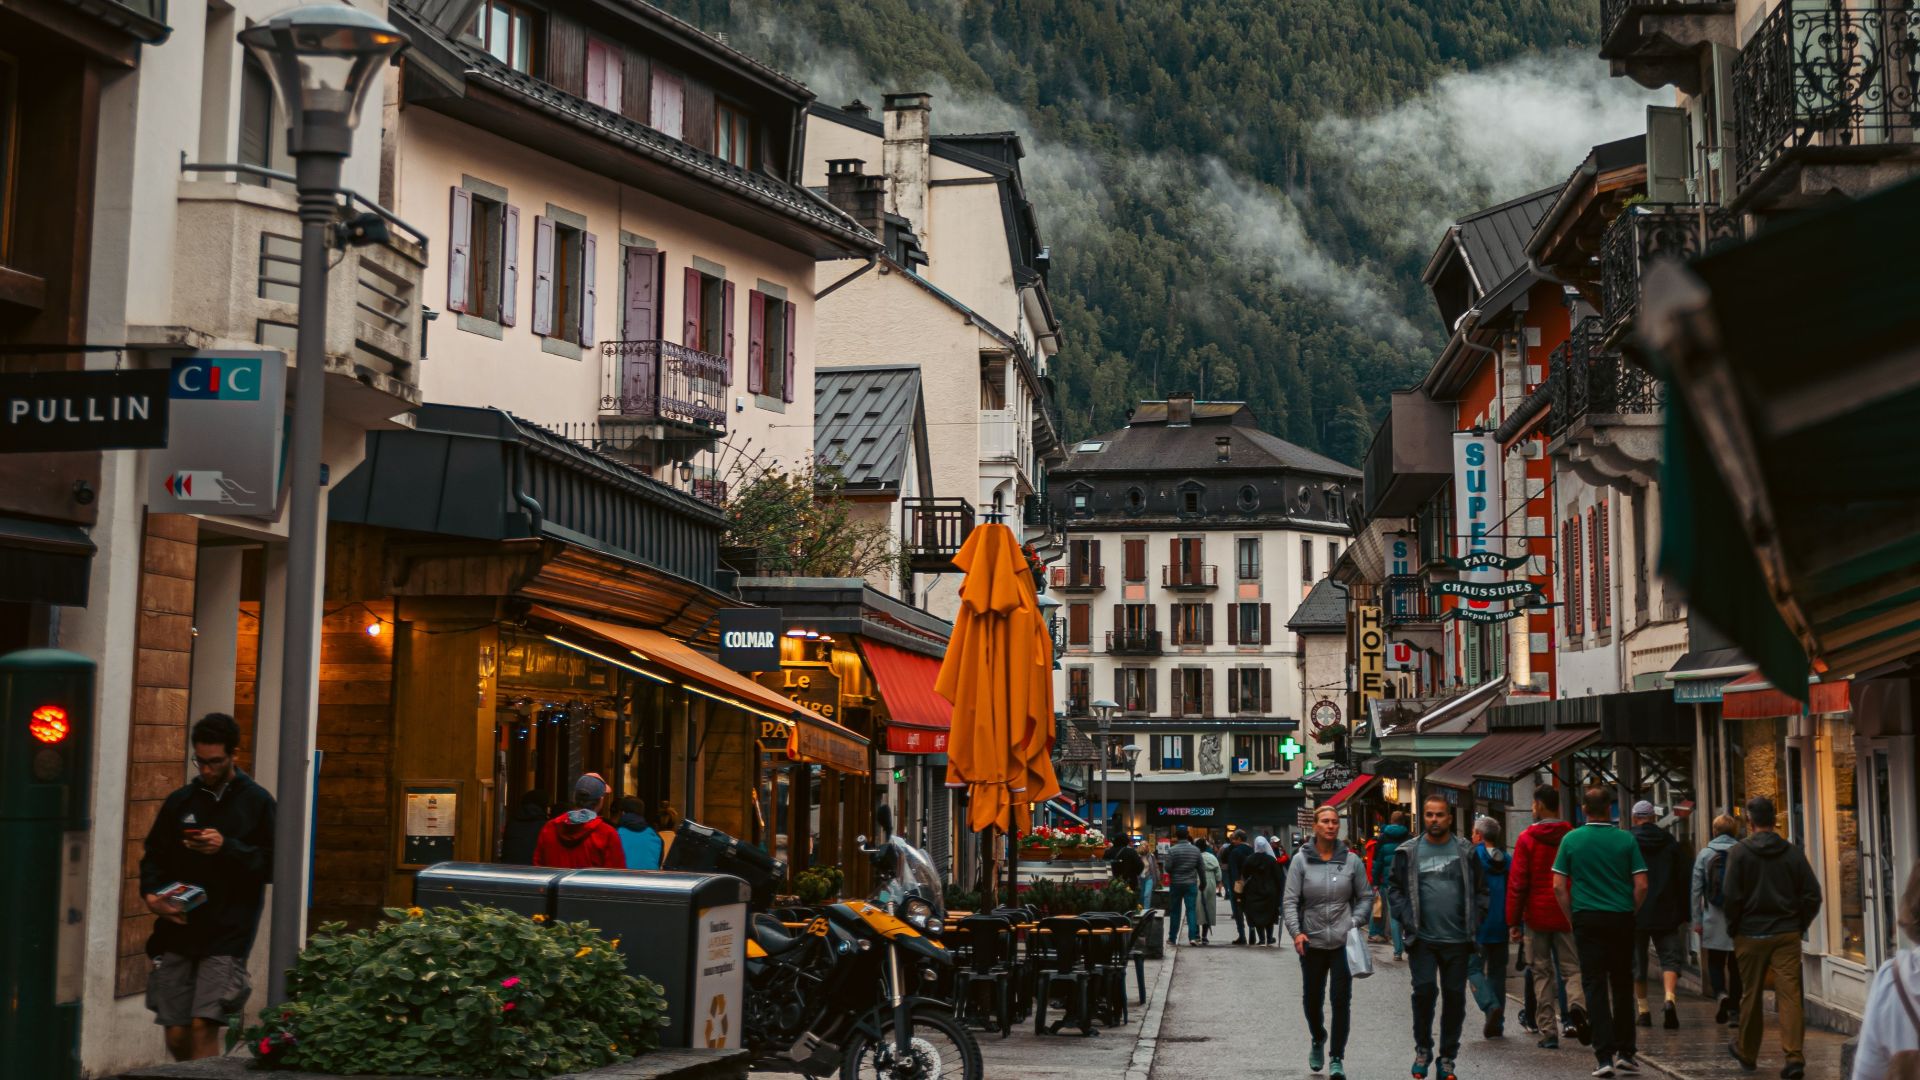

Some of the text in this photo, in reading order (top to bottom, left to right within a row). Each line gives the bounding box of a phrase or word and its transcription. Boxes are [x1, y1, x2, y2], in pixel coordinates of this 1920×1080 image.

[178, 365, 252, 393] CIC
[10, 396, 150, 424] PULLIN
[1464, 555, 1508, 568] PAYOT
[1442, 582, 1533, 597] CHAUSSURES
[1462, 610, 1515, 621] Depuis 1860
[725, 631, 775, 648] COLMAR
[1394, 645, 1411, 662] U
[783, 669, 811, 689] Le
[1167, 807, 1215, 816] INTERSPORT
